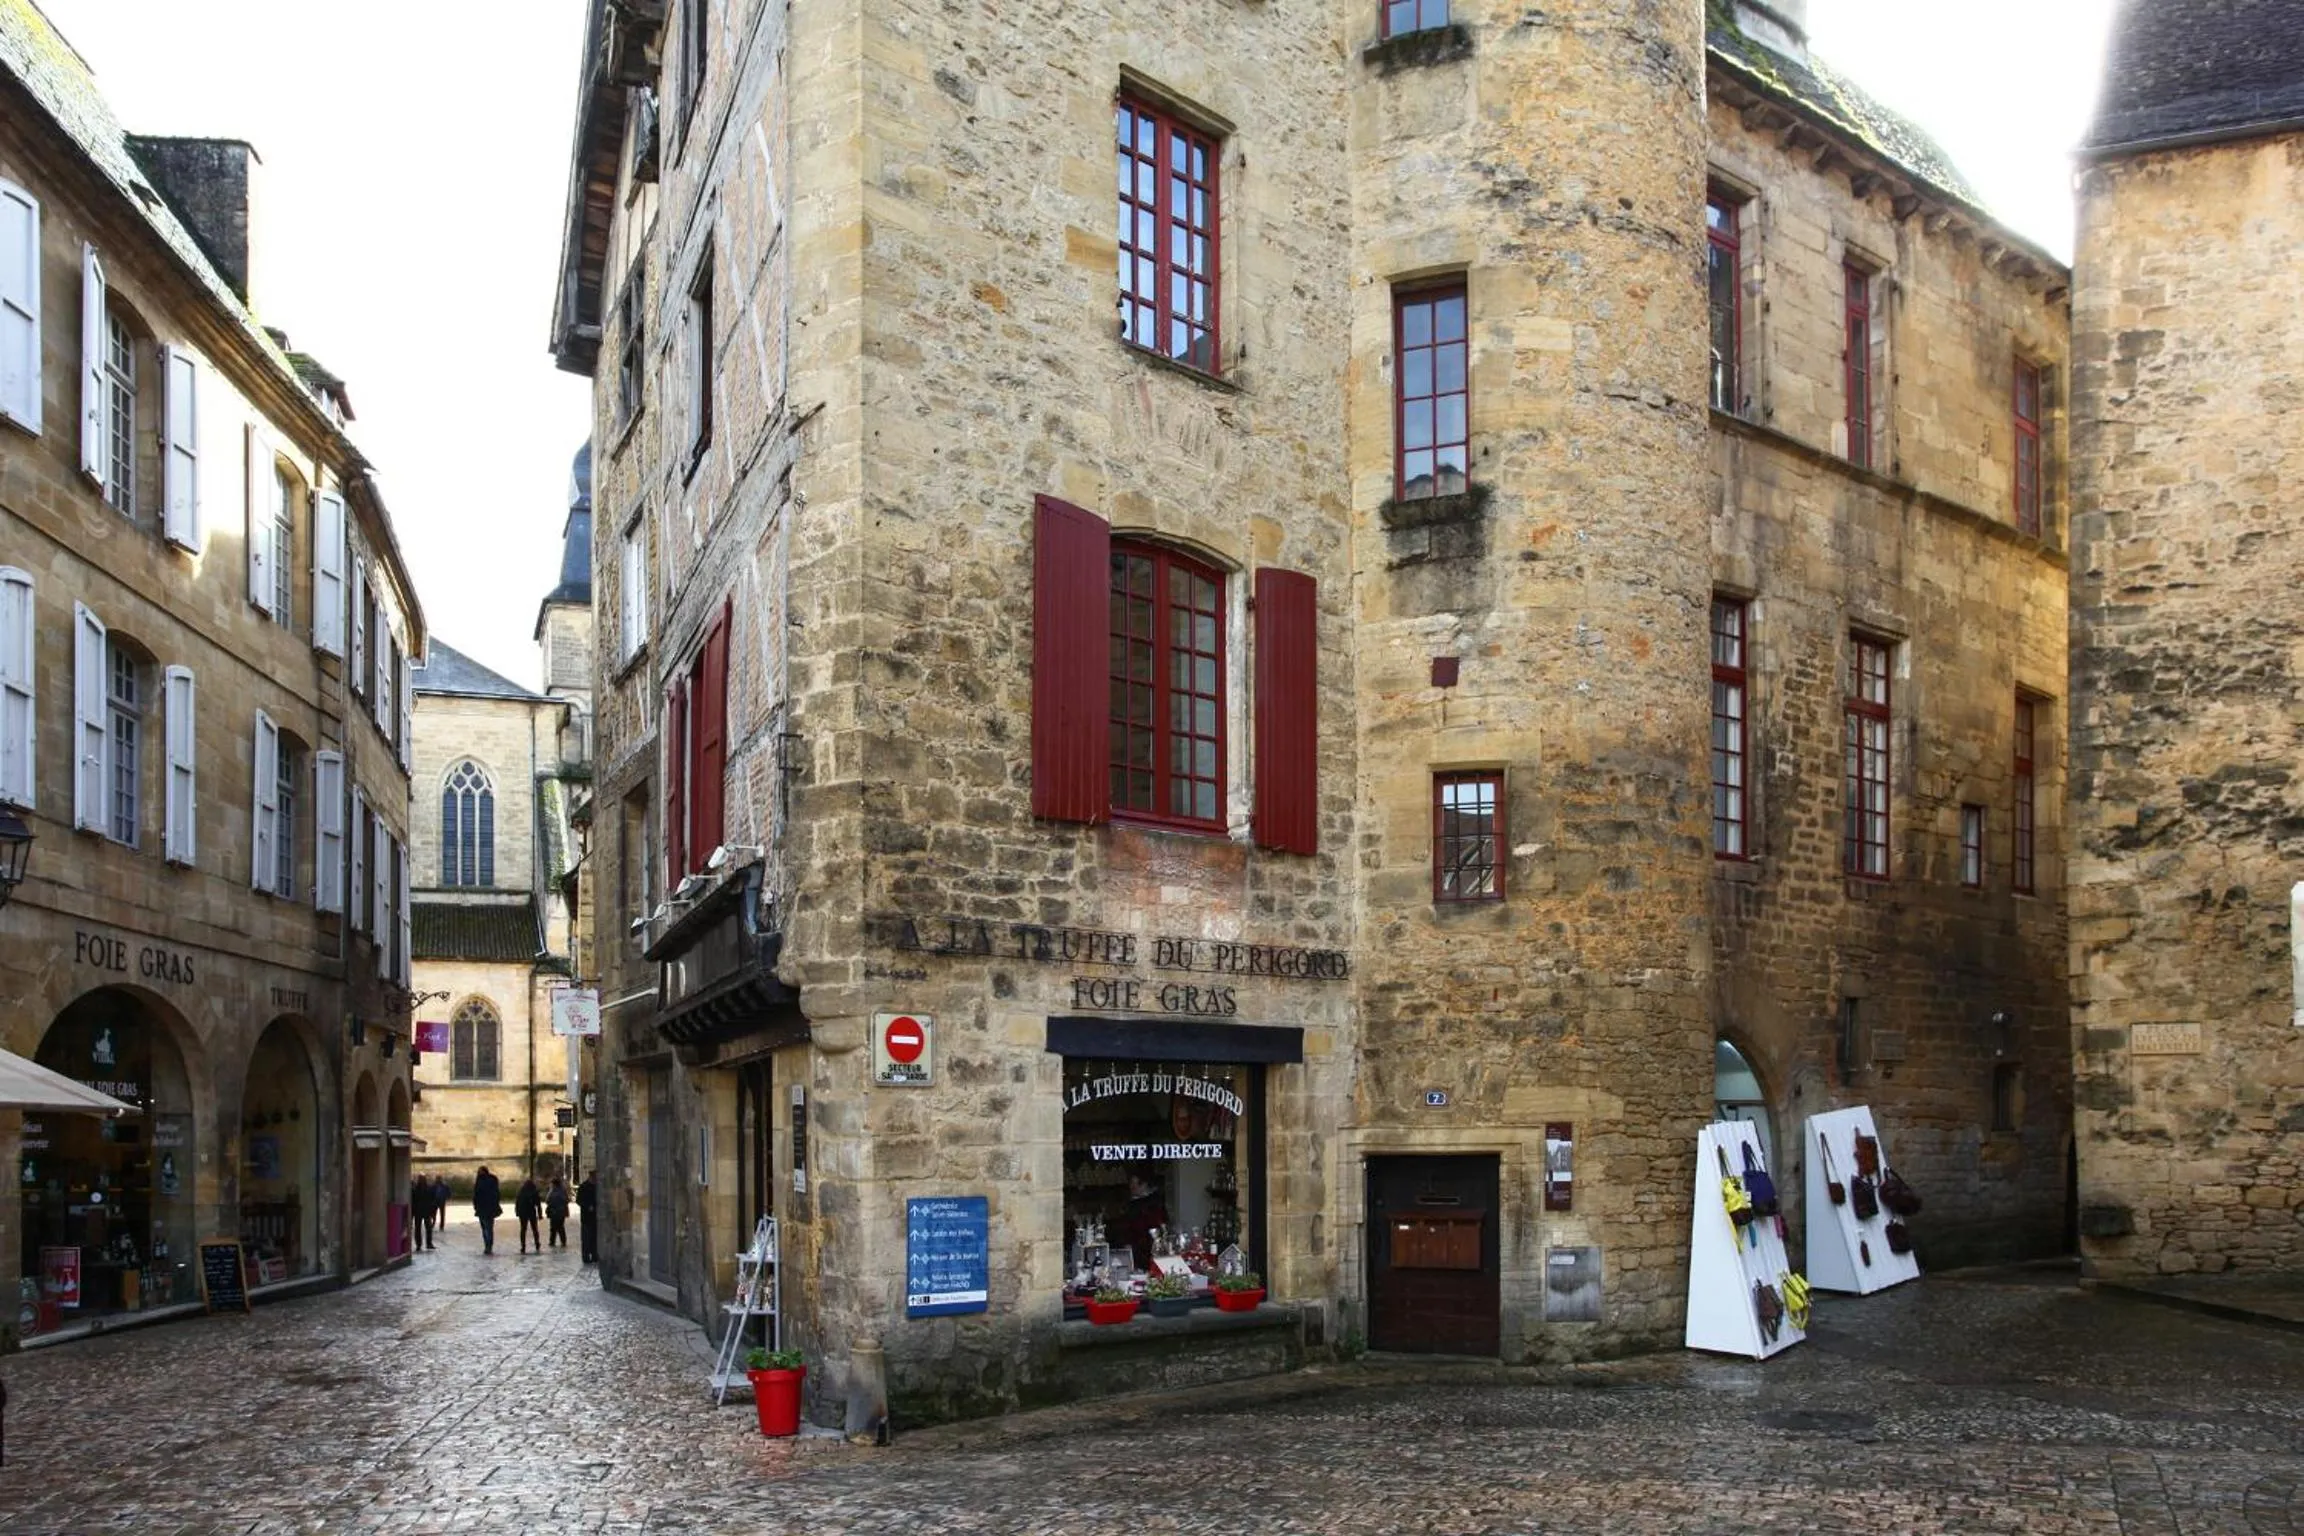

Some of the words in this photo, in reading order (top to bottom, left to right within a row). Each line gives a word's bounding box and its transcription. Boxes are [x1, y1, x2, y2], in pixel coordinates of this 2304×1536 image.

[75, 931, 127, 972] FOIE
[139, 947, 195, 985] GRAS
[1010, 926, 1138, 964] TRUFFE
[1154, 937, 1194, 969] DU
[1211, 944, 1348, 977] PERIGORD
[1070, 978, 1141, 1009] FOIE
[1160, 984, 1238, 1015] GRAS
[1071, 1082, 1092, 1107] LA
[1093, 1073, 1150, 1098] TRUFFE
[1152, 1074, 1172, 1094] DU
[1175, 1076, 1244, 1117] PERIGORD
[1090, 1144, 1147, 1161] VENTE
[1151, 1143, 1222, 1160] DIRECTE
